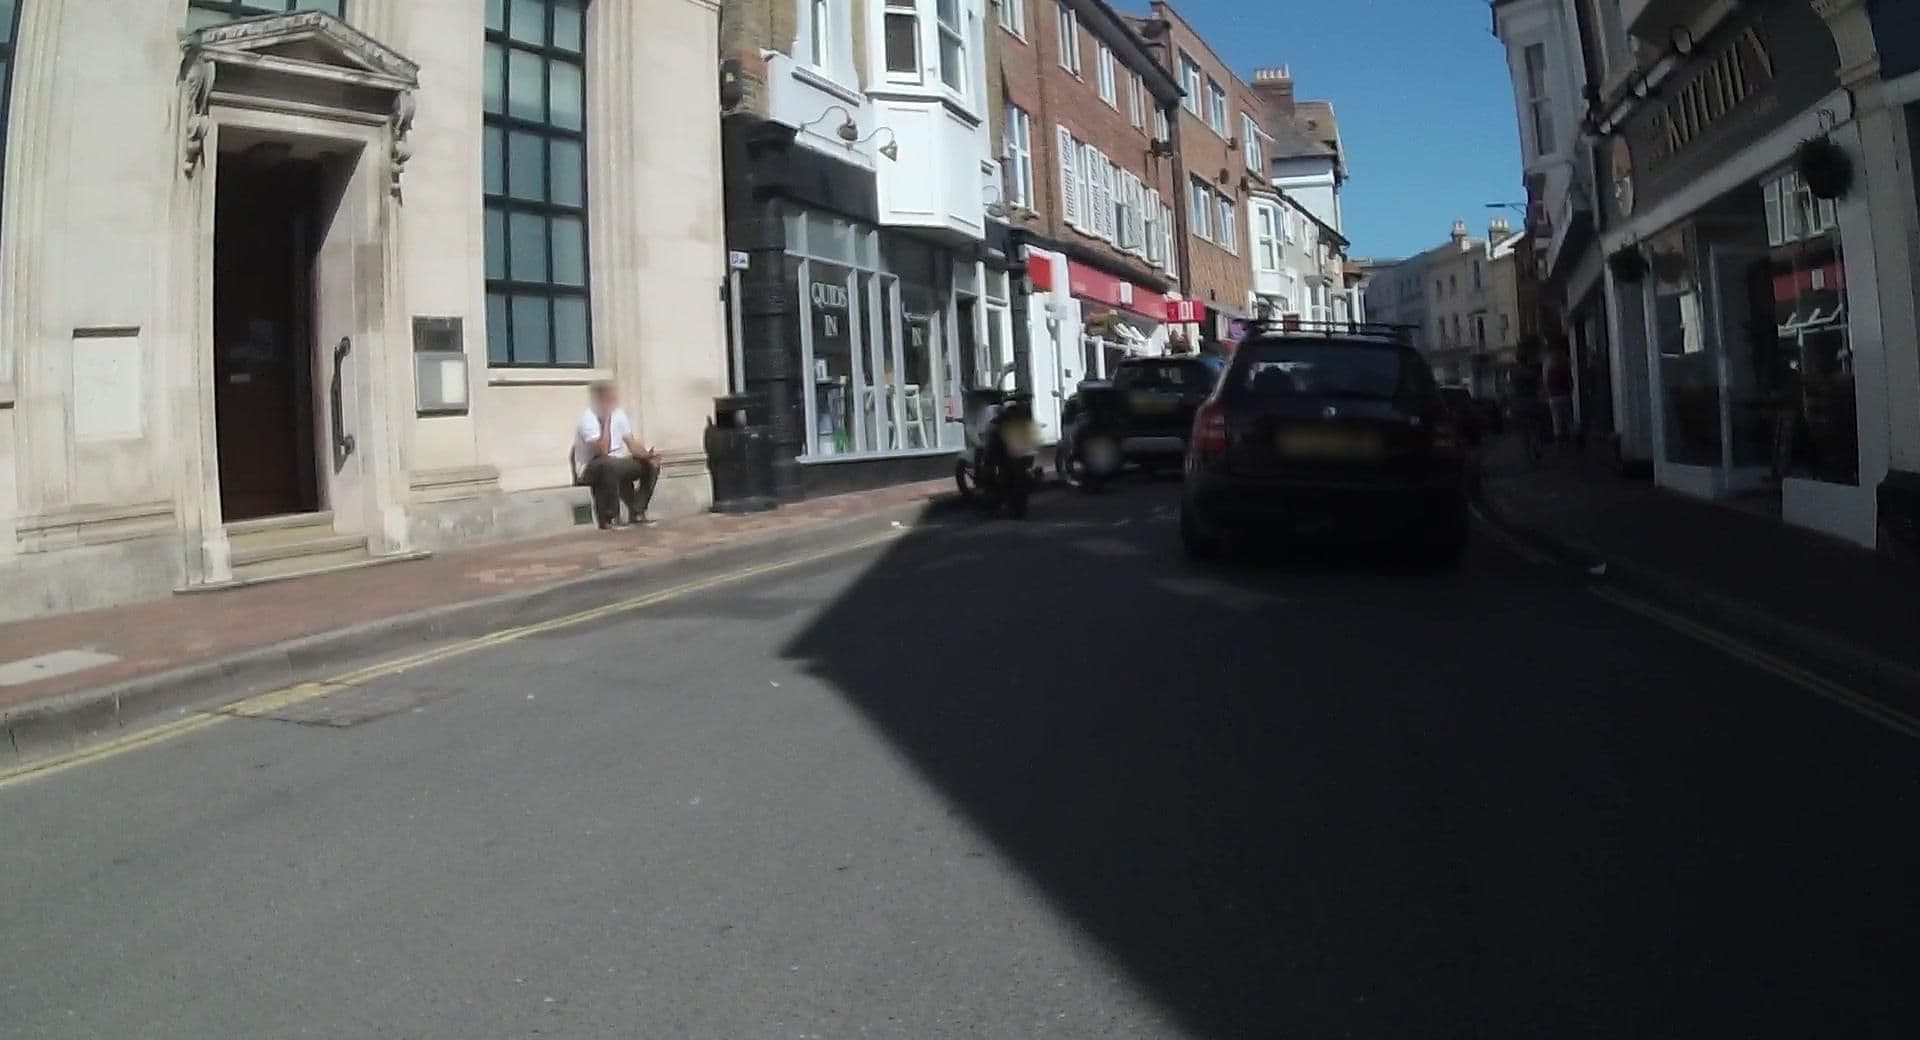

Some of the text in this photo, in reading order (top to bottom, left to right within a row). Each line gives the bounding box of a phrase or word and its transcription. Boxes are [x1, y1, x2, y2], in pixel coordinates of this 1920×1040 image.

[1664, 23, 1775, 153] KITCHEN
[811, 282, 849, 309] QUIDS
[824, 314, 839, 337] IN
